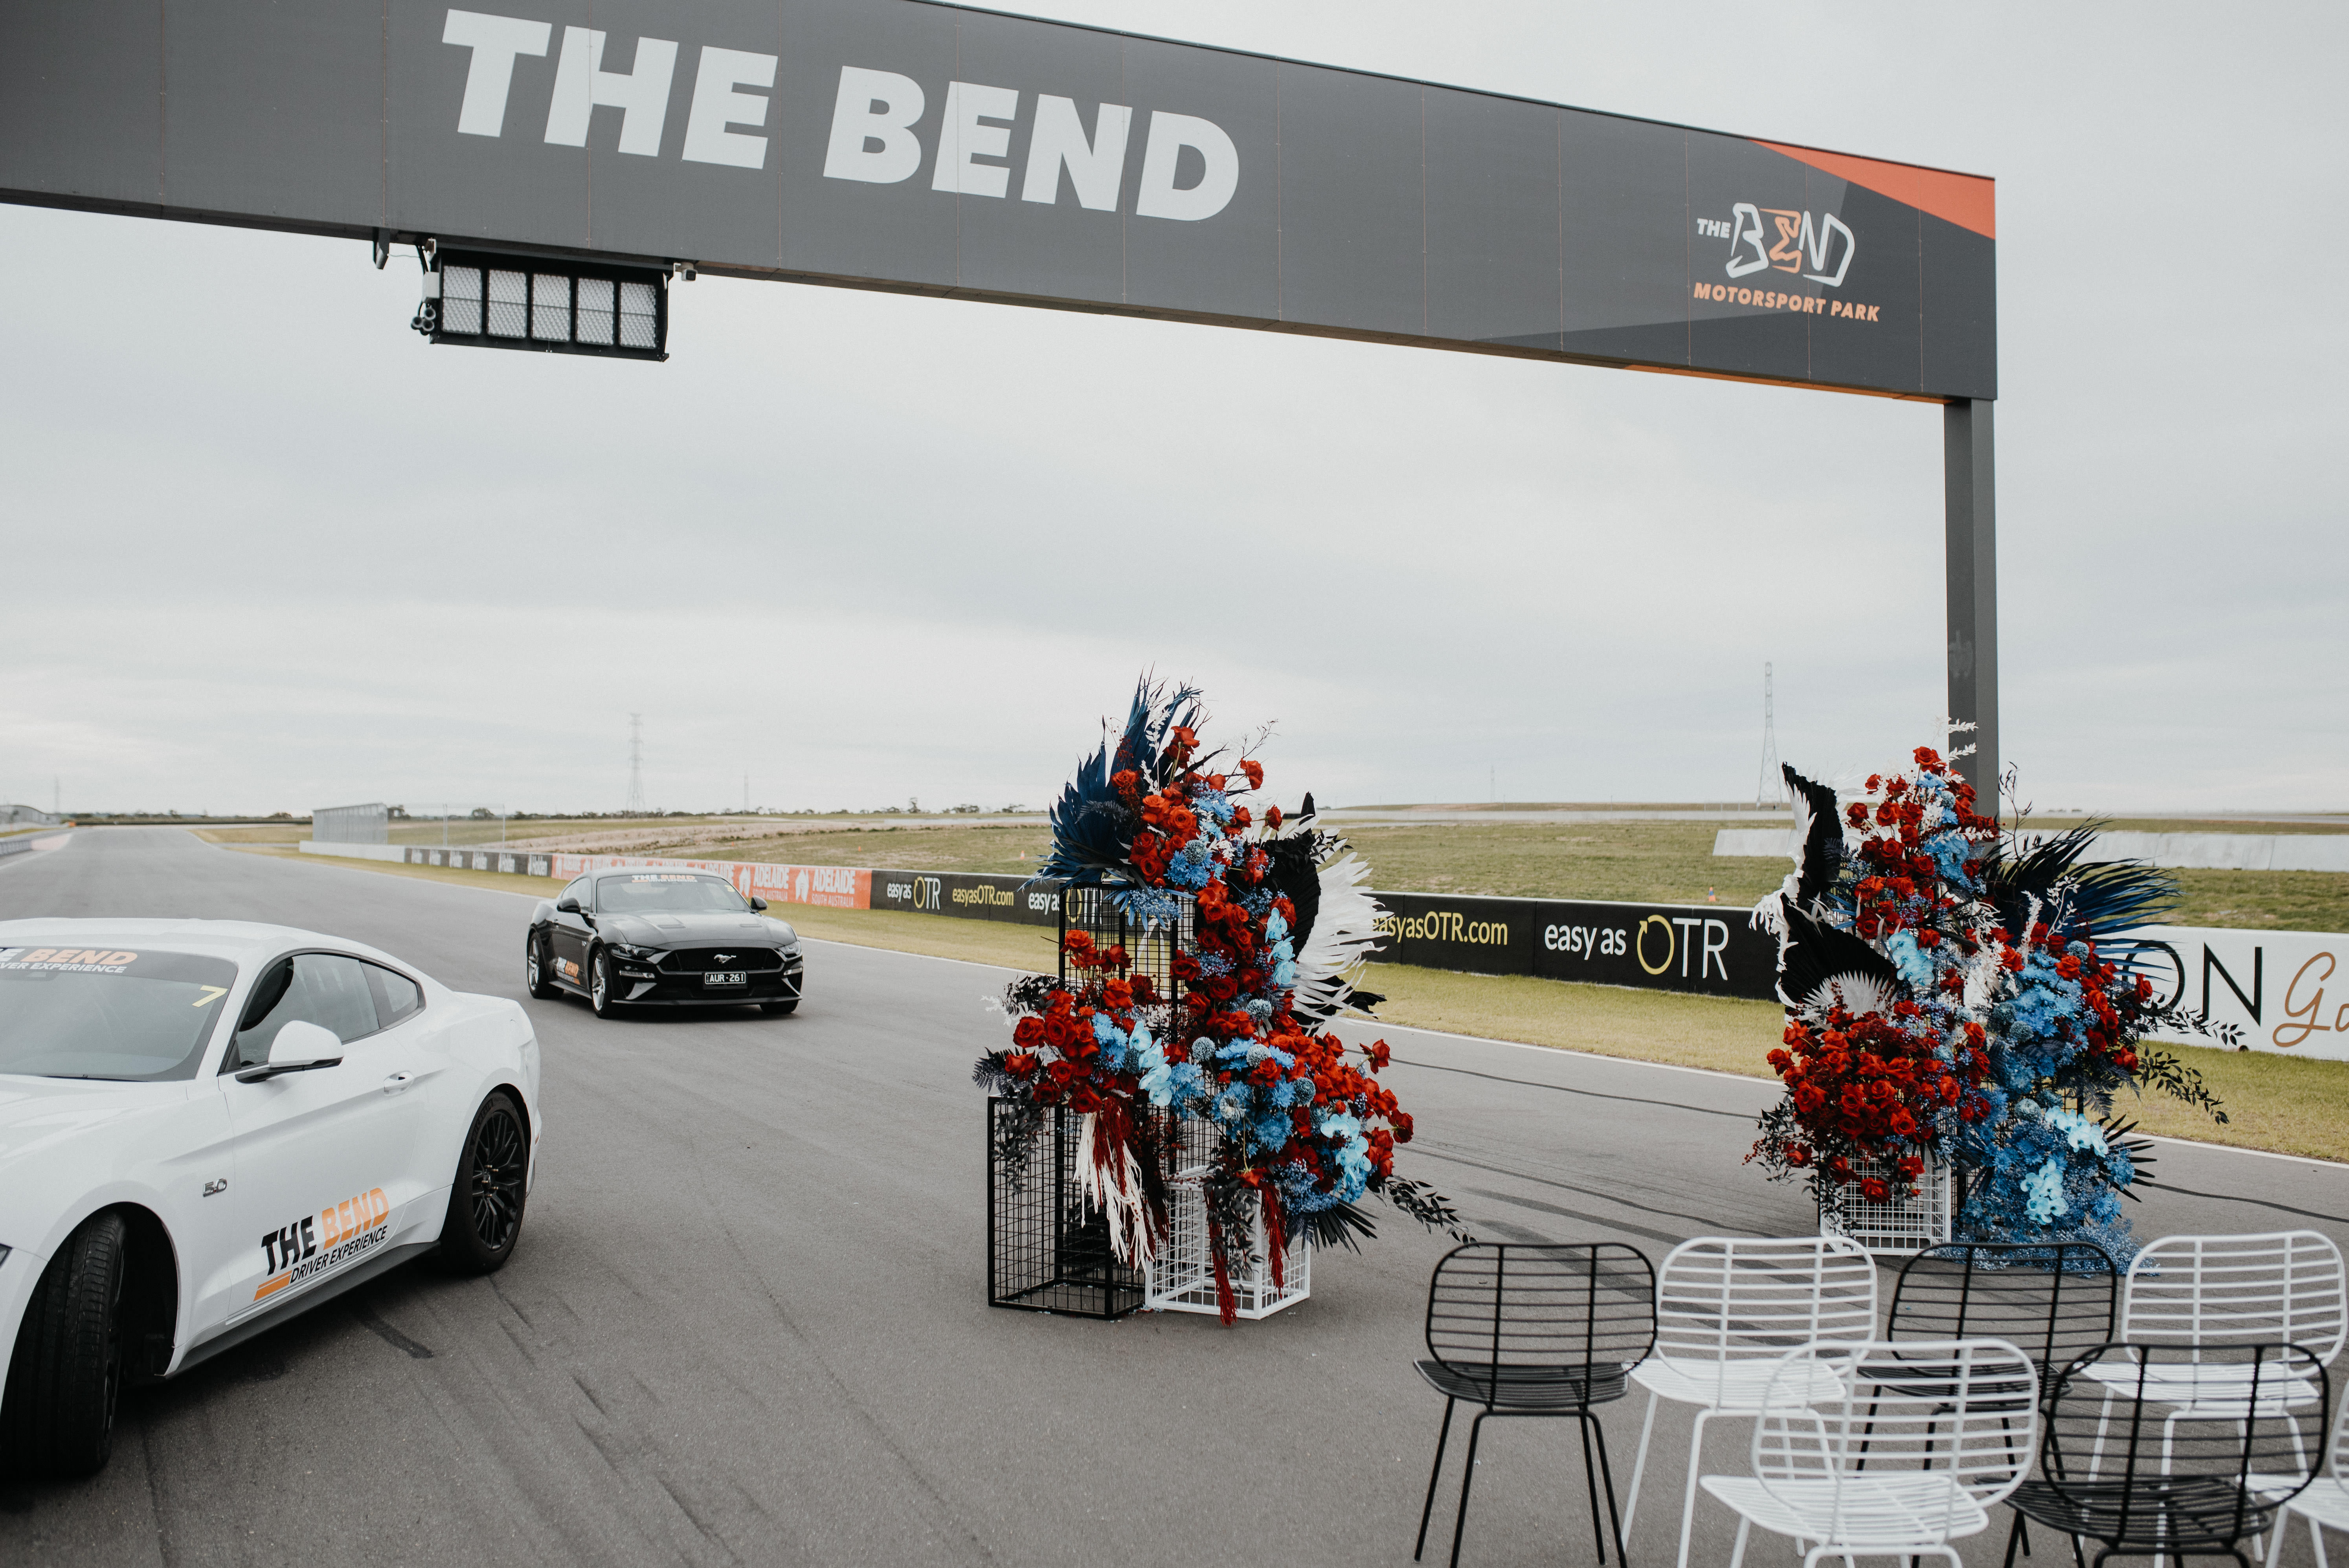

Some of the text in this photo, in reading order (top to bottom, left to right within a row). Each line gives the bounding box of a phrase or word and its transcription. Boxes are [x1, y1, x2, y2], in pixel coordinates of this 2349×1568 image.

[443, 9, 1239, 222] THE BEND
[1697, 218, 1731, 239] THE
[1726, 202, 1855, 287] BEND
[1693, 282, 1880, 322] MOTORSPORT PARK
[753, 866, 789, 889] ADELAIDE
[812, 868, 856, 894] ADELAIDE
[887, 876, 940, 910] easy as OTR
[952, 885, 1014, 907] easyasOTR.com
[1028, 892, 1051, 915] easy
[20, 948, 138, 965] BEND
[1545, 914, 1728, 980] easy as OTR
[30, 962, 127, 973] EXPERIENCE
[192, 985, 228, 1007] 7
[202, 1178, 228, 1197] 5.0
[261, 1187, 389, 1276] THE BEND
[290, 1225, 388, 1284] DRIVER EXPERIENCE
